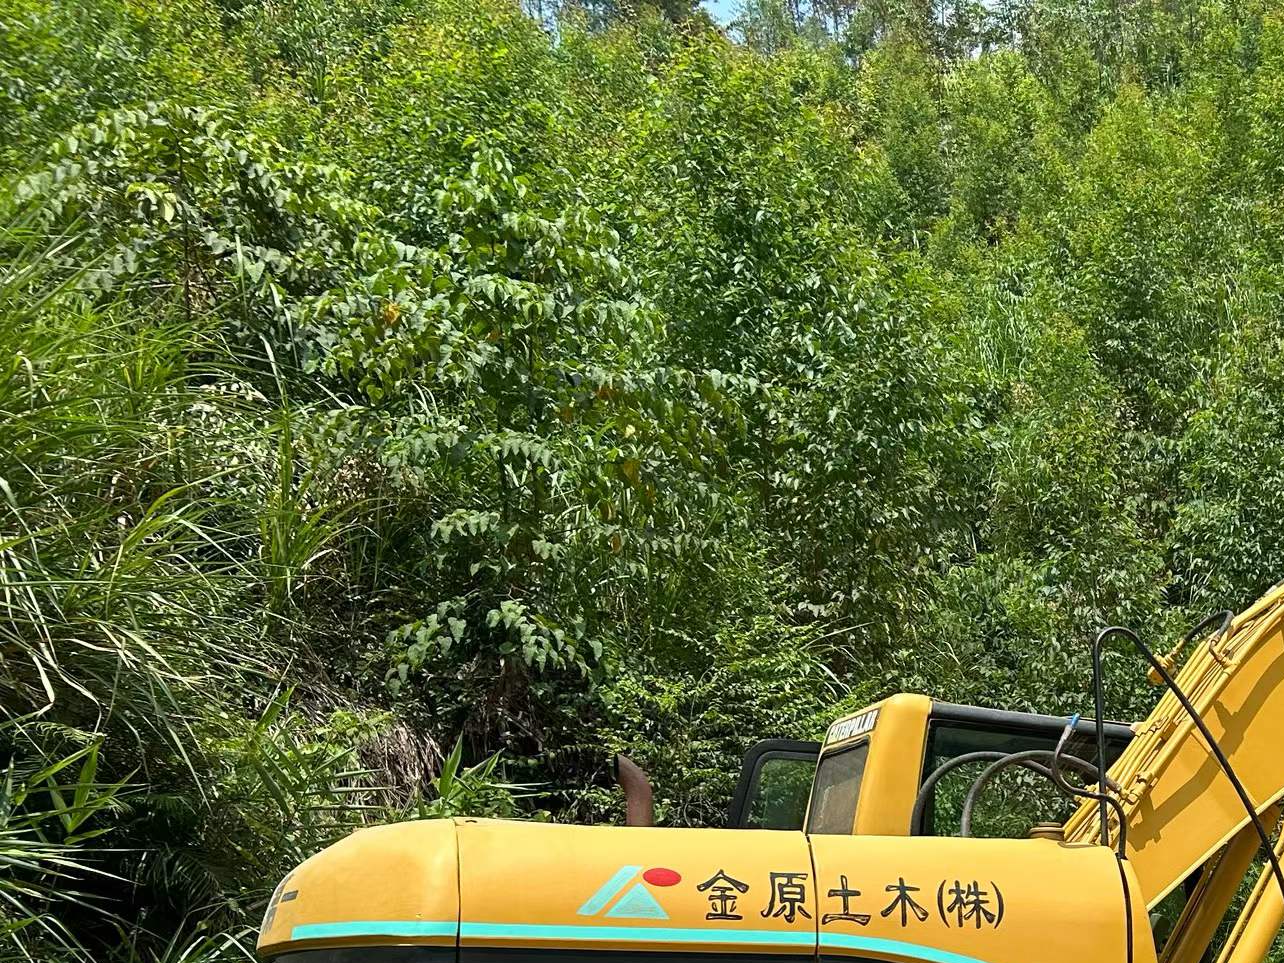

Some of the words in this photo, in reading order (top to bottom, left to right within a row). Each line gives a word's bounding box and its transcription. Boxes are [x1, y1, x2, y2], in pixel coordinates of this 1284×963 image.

[697, 869, 1005, 930] 金原土木(株)
